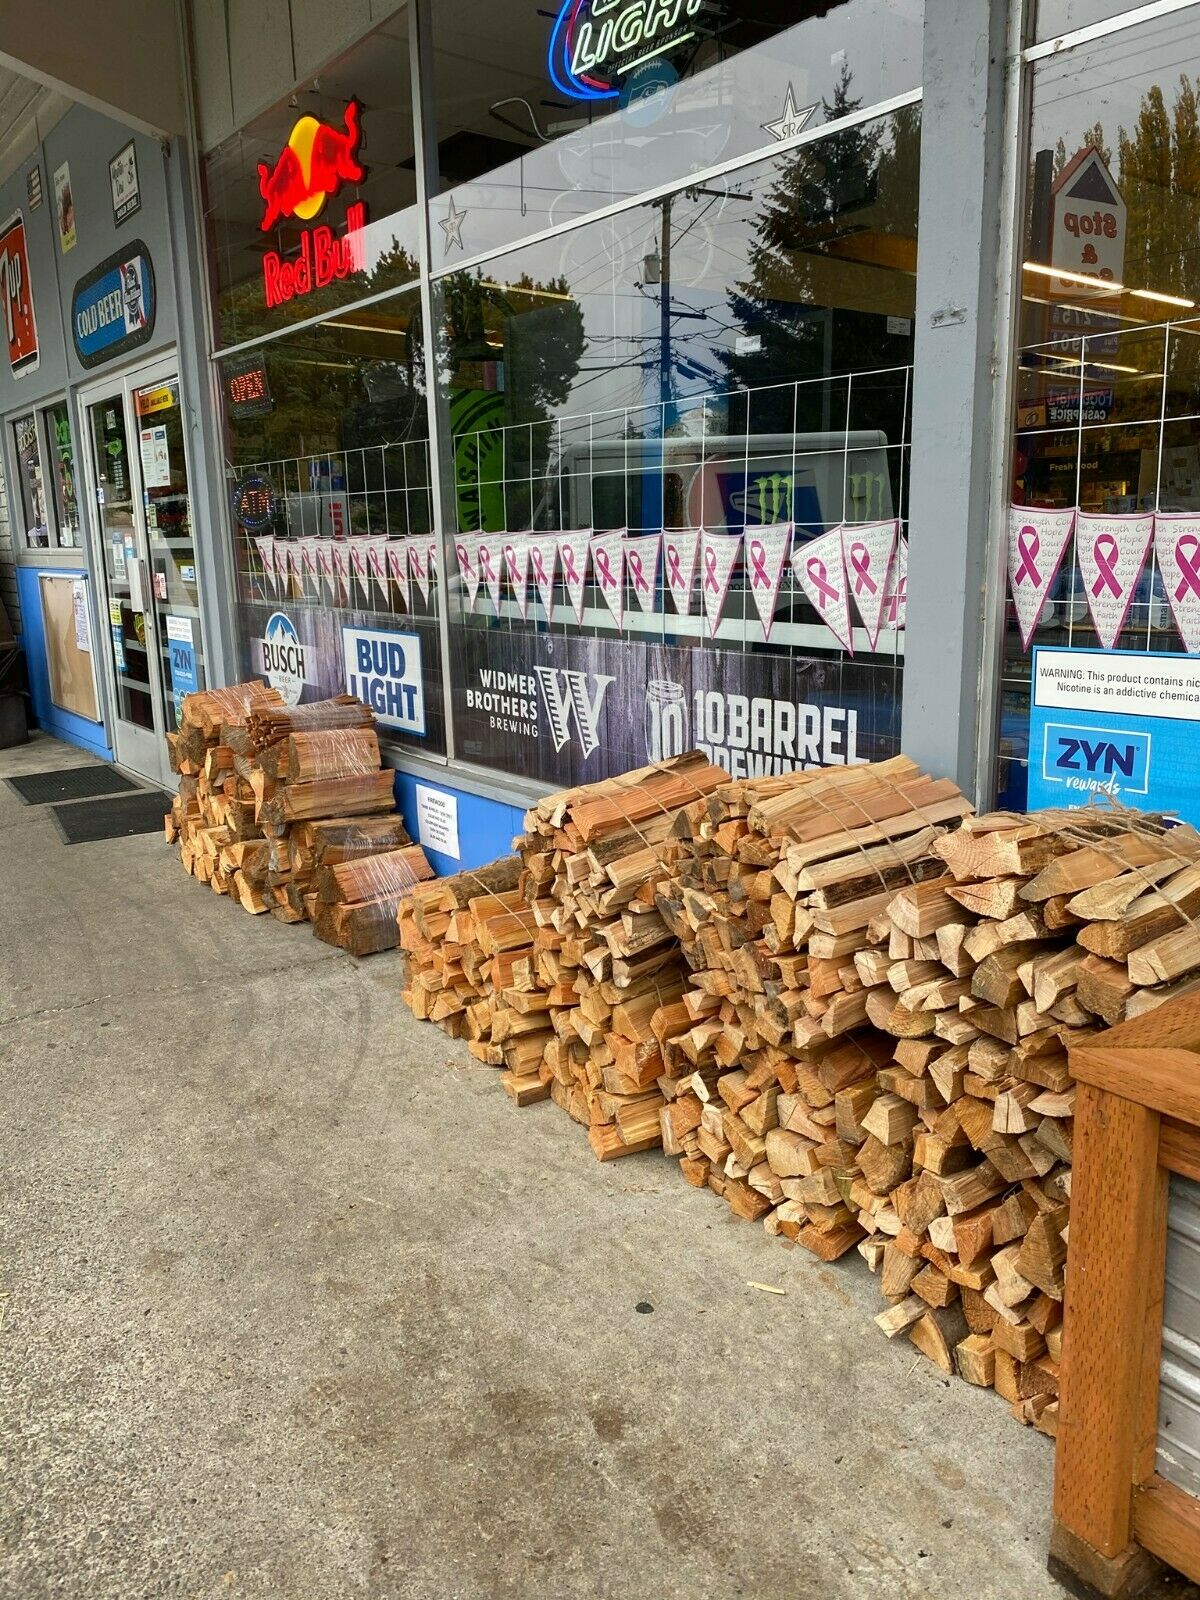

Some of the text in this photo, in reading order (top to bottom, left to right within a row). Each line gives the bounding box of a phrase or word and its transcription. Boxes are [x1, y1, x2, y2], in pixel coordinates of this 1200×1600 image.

[263, 201, 368, 308] Red Bull
[77, 288, 124, 339] COLD BEER
[1075, 460, 1099, 471] ood
[1041, 527, 1063, 539] Hope
[1092, 523, 1130, 535] Strength
[1119, 536, 1144, 547] Hope
[1097, 611, 1118, 620] Faith
[172, 647, 192, 672] ZYN
[262, 642, 306, 681] BUSCH
[355, 638, 406, 680] BUD
[479, 668, 538, 696] WIDMER
[1040, 667, 1085, 680] WARNING:
[1087, 670, 1105, 681] This
[1107, 673, 1142, 684] product
[1143, 675, 1184, 687] contains
[1057, 682, 1092, 694] Nicotine
[1093, 684, 1101, 694] is
[1103, 687, 1114, 696] an
[1116, 686, 1157, 699] addictive
[466, 690, 538, 722] BROTHERS
[489, 715, 539, 738] BREWING
[1056, 737, 1135, 777] ZYN
[1066, 770, 1122, 795] rewards
